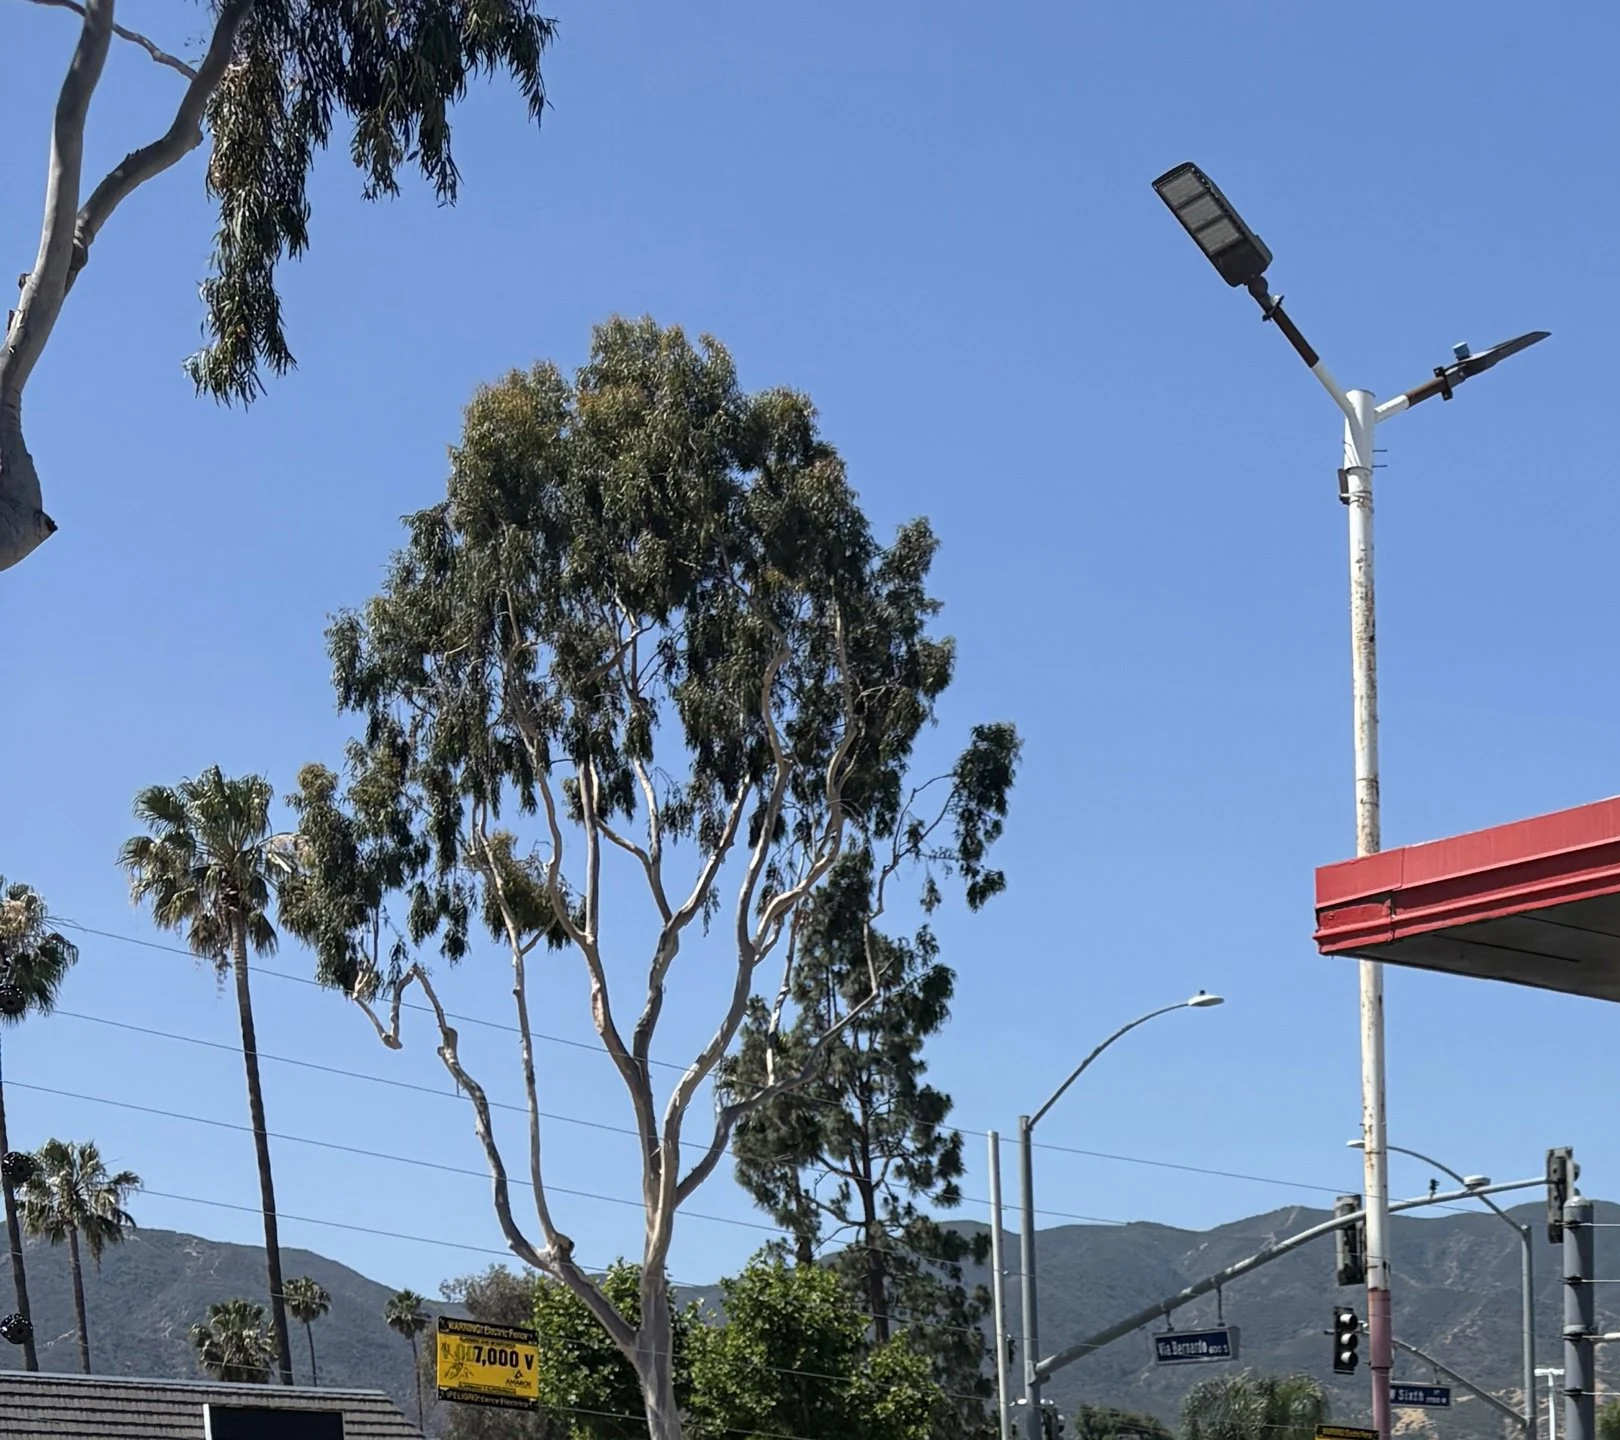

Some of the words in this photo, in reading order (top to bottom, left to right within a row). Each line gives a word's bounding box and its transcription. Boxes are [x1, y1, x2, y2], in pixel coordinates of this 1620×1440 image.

[473, 1345, 519, 1368] 7,000
[524, 1354, 534, 1370] V
[1398, 1389, 1424, 1402] Sixth
